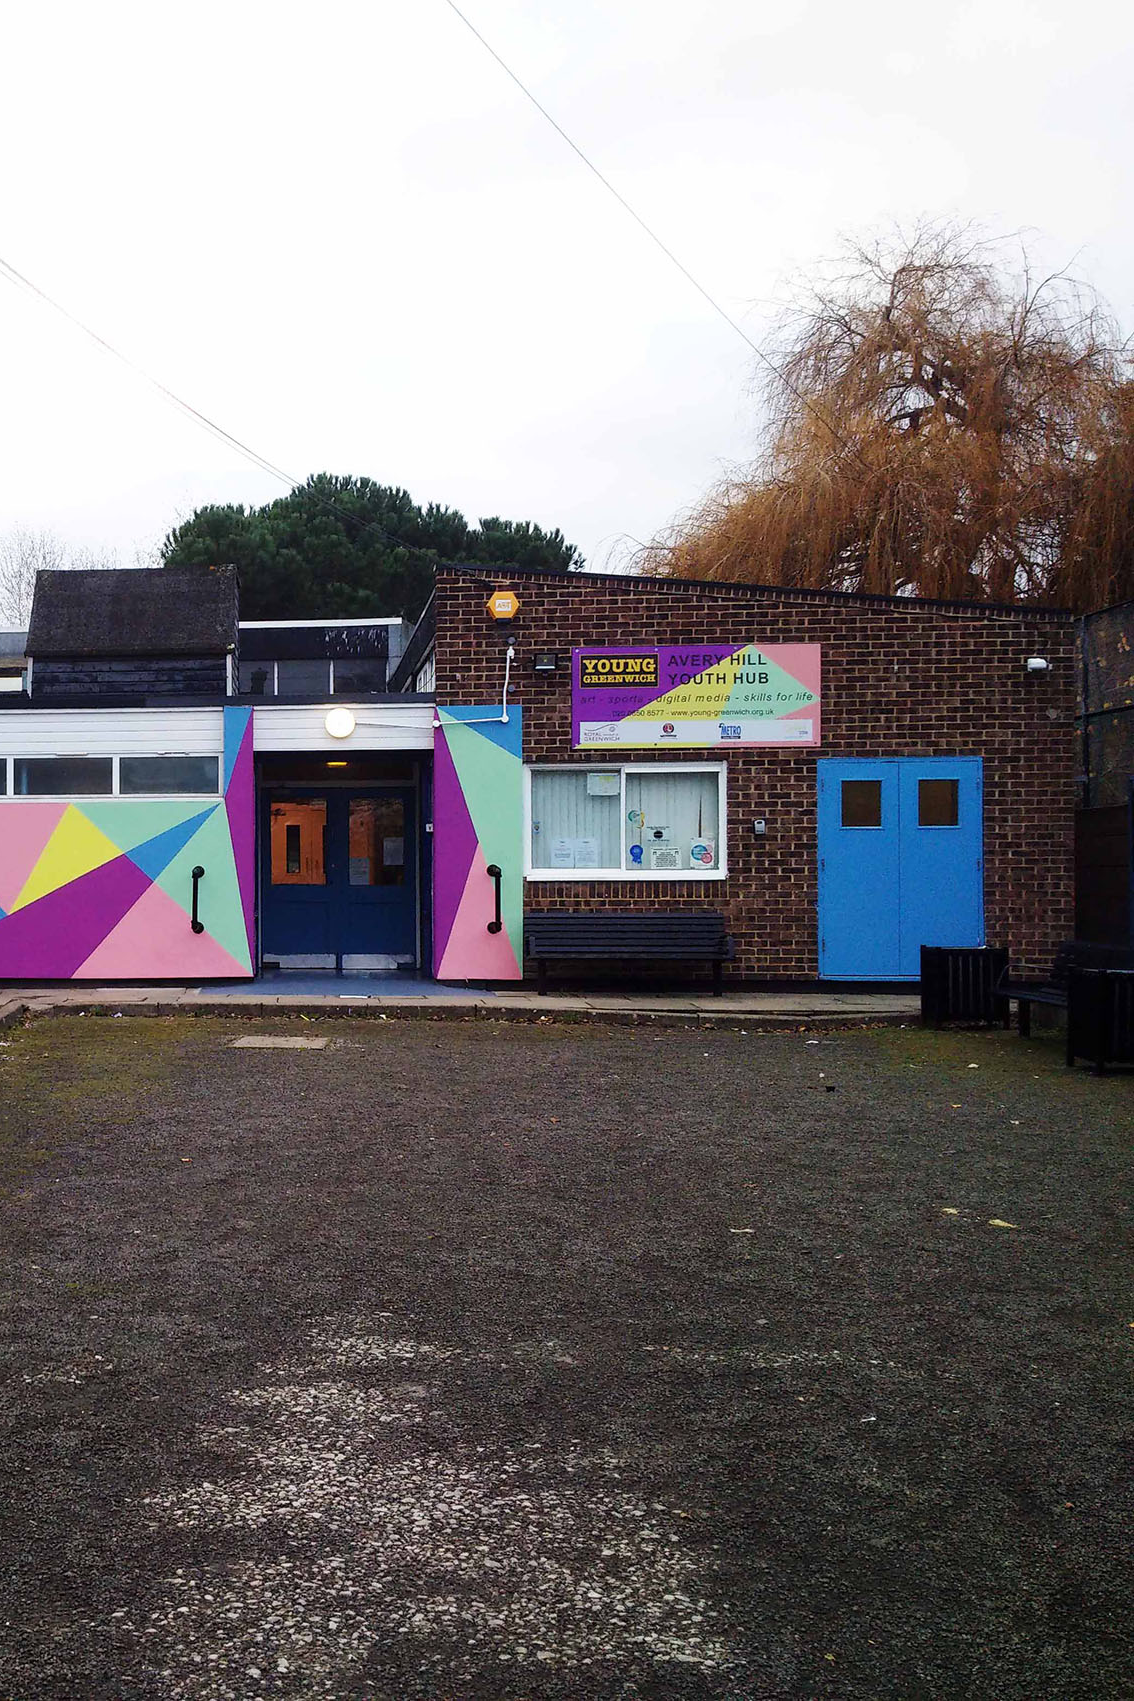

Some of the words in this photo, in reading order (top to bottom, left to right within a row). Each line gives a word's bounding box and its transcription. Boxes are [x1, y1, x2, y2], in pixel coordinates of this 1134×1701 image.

[582, 658, 656, 673] YOUNG
[668, 654, 725, 666] AVERY
[730, 653, 767, 665] HILL
[583, 674, 656, 683] GREENWICH
[668, 673, 726, 685] YOUTH
[733, 672, 769, 684] HUB
[580, 696, 596, 704] art
[608, 695, 644, 704] sports
[656, 694, 691, 704] digital
[695, 693, 731, 702] media
[743, 692, 772, 702] skills
[776, 692, 792, 701] for
[796, 691, 813, 701] life
[721, 725, 742, 735] METRO
